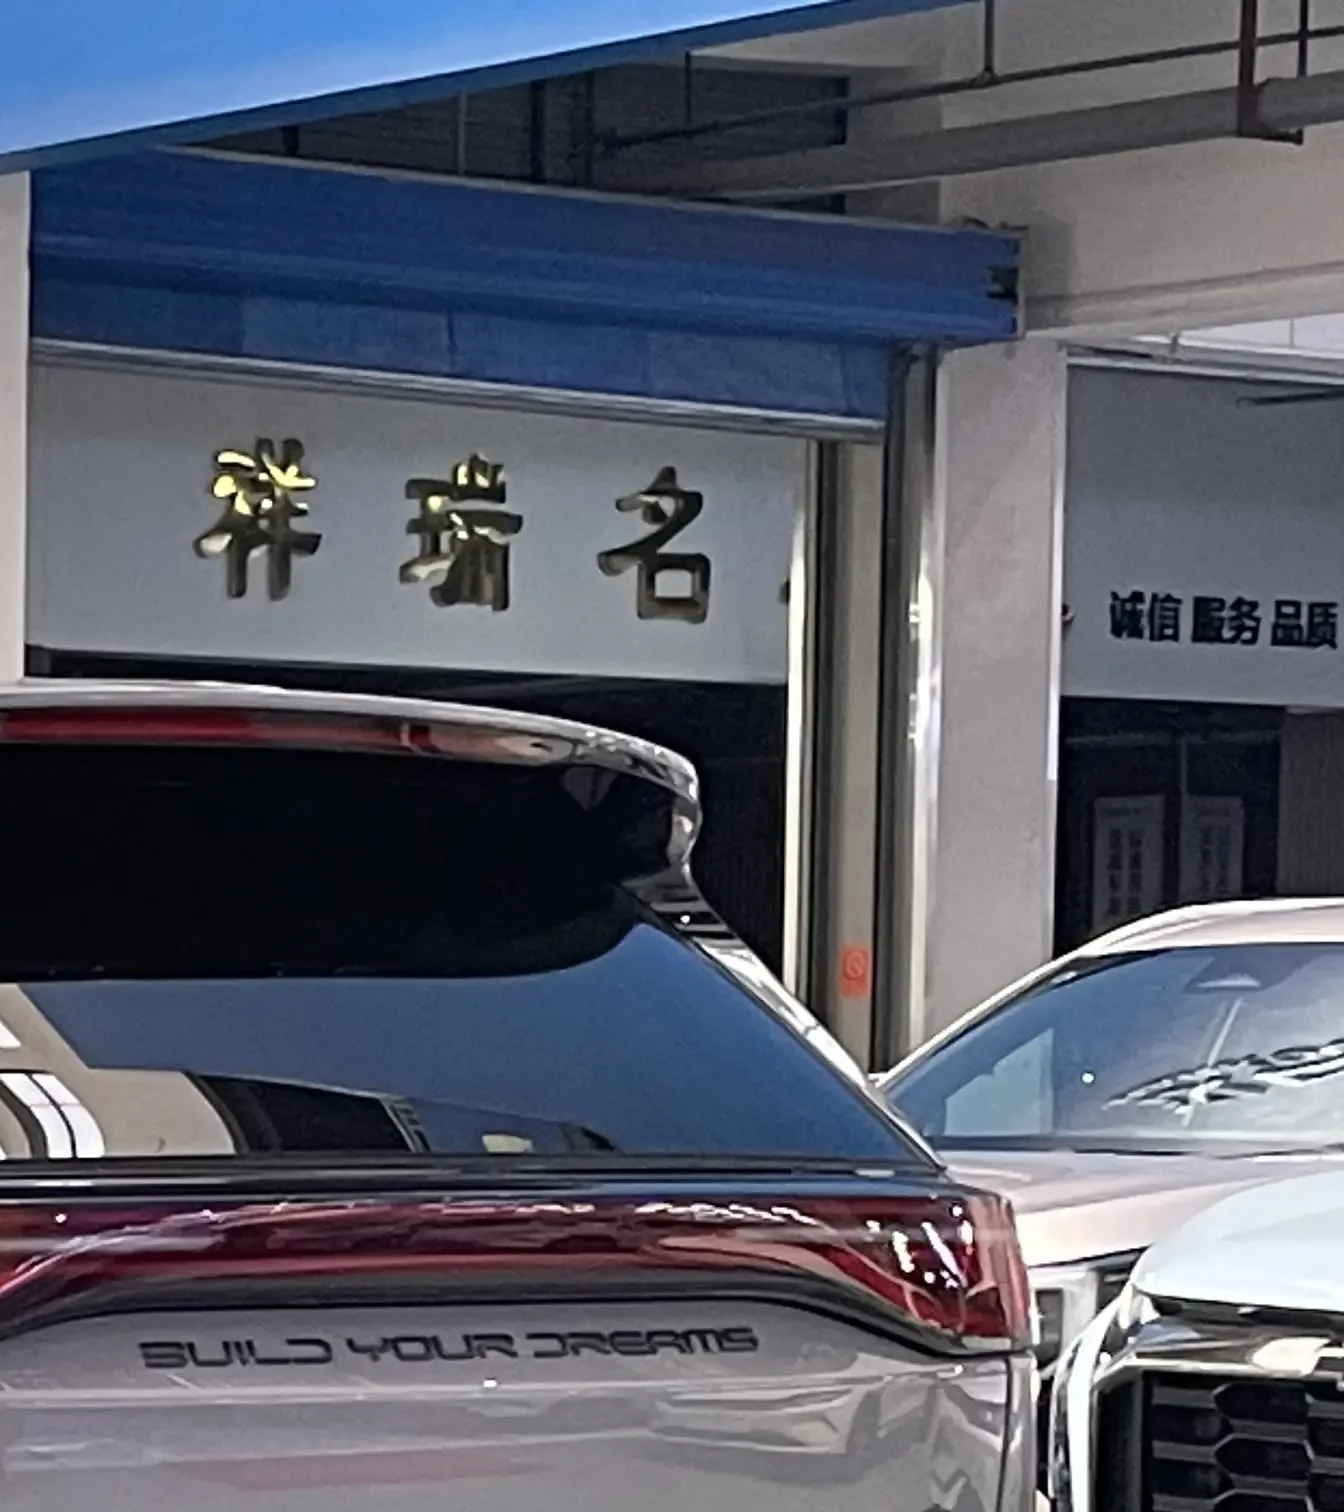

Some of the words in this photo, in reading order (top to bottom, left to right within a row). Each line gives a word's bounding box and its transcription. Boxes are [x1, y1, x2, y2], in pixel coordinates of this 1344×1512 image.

[192, 438, 790, 623] 祥瑞名
[1109, 590, 1183, 642] 诚信
[1190, 596, 1261, 645] 服务
[1269, 600, 1338, 650] 品质
[137, 1339, 333, 1369] BUILD
[346, 1333, 519, 1362] YOUR
[525, 1326, 759, 1358] DREAMS
